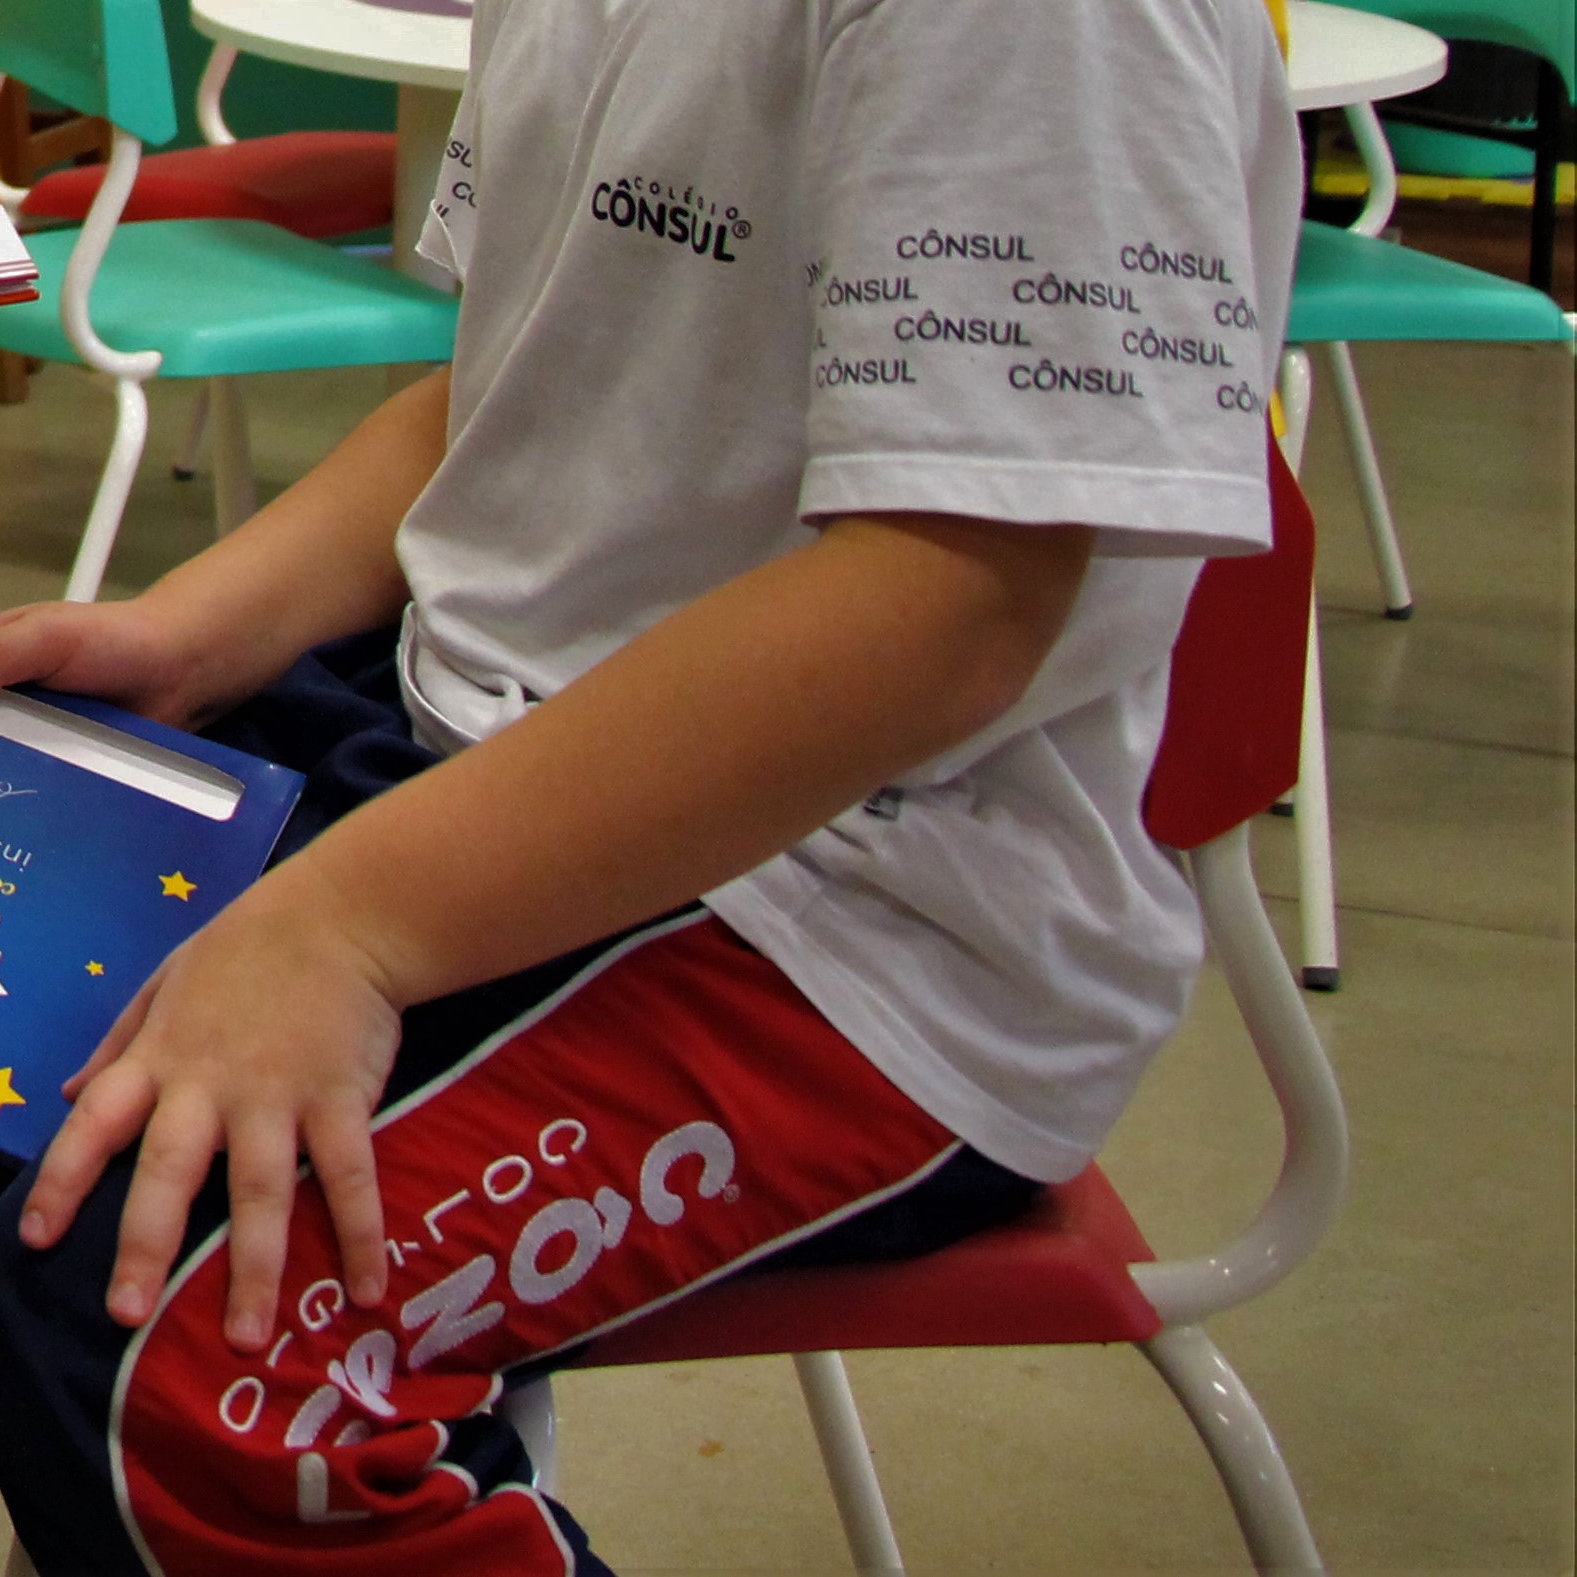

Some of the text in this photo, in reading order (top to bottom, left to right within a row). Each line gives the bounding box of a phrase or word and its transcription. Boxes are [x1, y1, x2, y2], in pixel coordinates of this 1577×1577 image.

[897, 228, 1233, 284] CÔNSUL CÔNSUL
[1013, 272, 1141, 314] CÔNSUL
[894, 309, 1234, 367] CÔNSUL CÔNSUL
[1009, 358, 1144, 398] CÔNSUL
